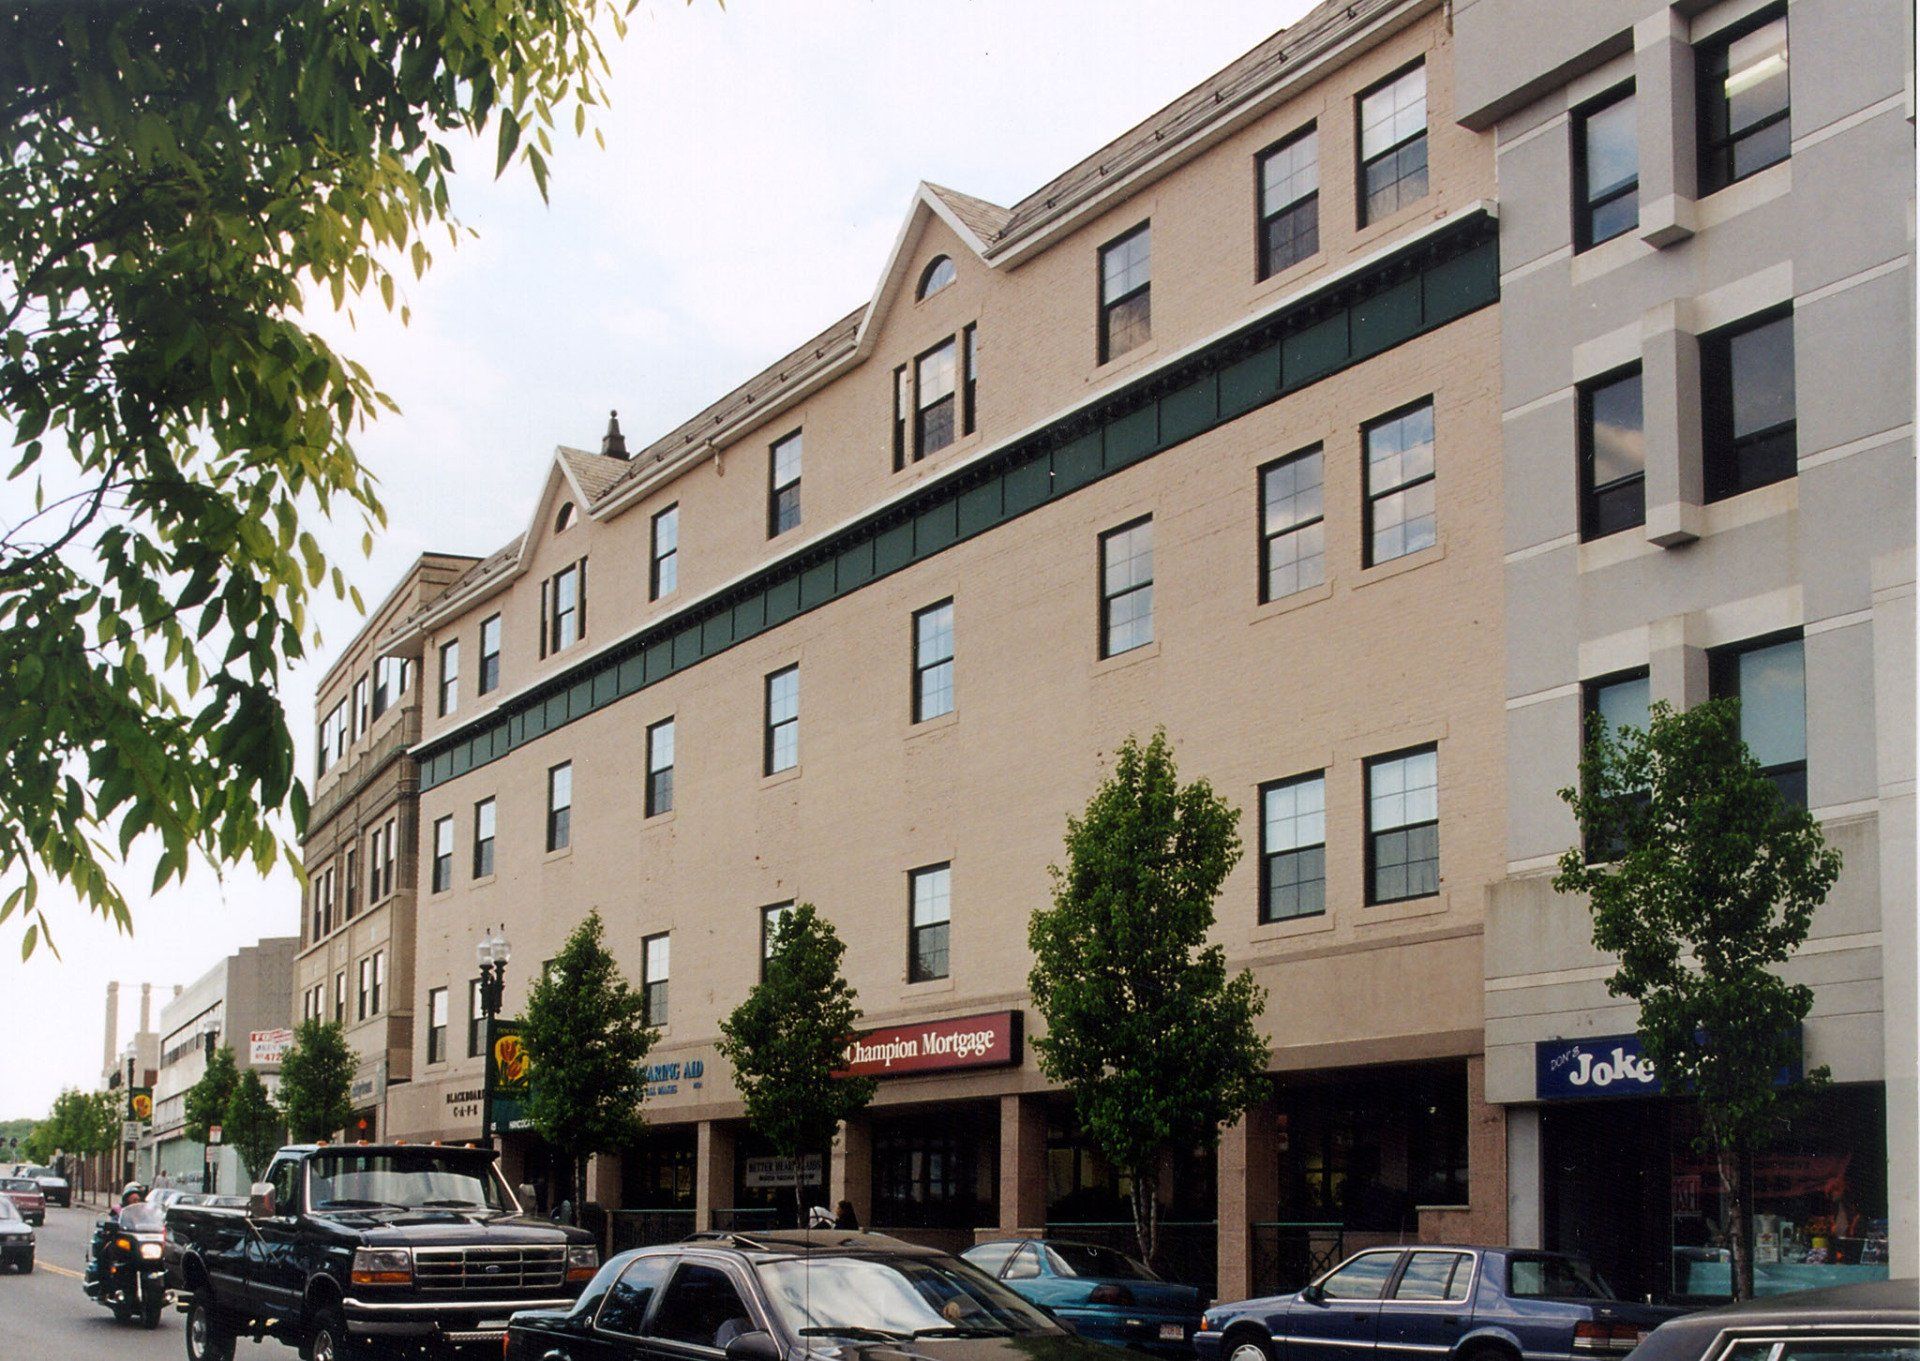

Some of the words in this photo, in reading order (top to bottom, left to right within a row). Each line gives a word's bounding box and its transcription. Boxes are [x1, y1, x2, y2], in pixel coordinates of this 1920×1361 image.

[847, 1036, 918, 1066] Champion
[922, 1030, 994, 1058] Mortgage
[684, 1060, 704, 1078] AID
[446, 1089, 485, 1103] BLACKBOAR
